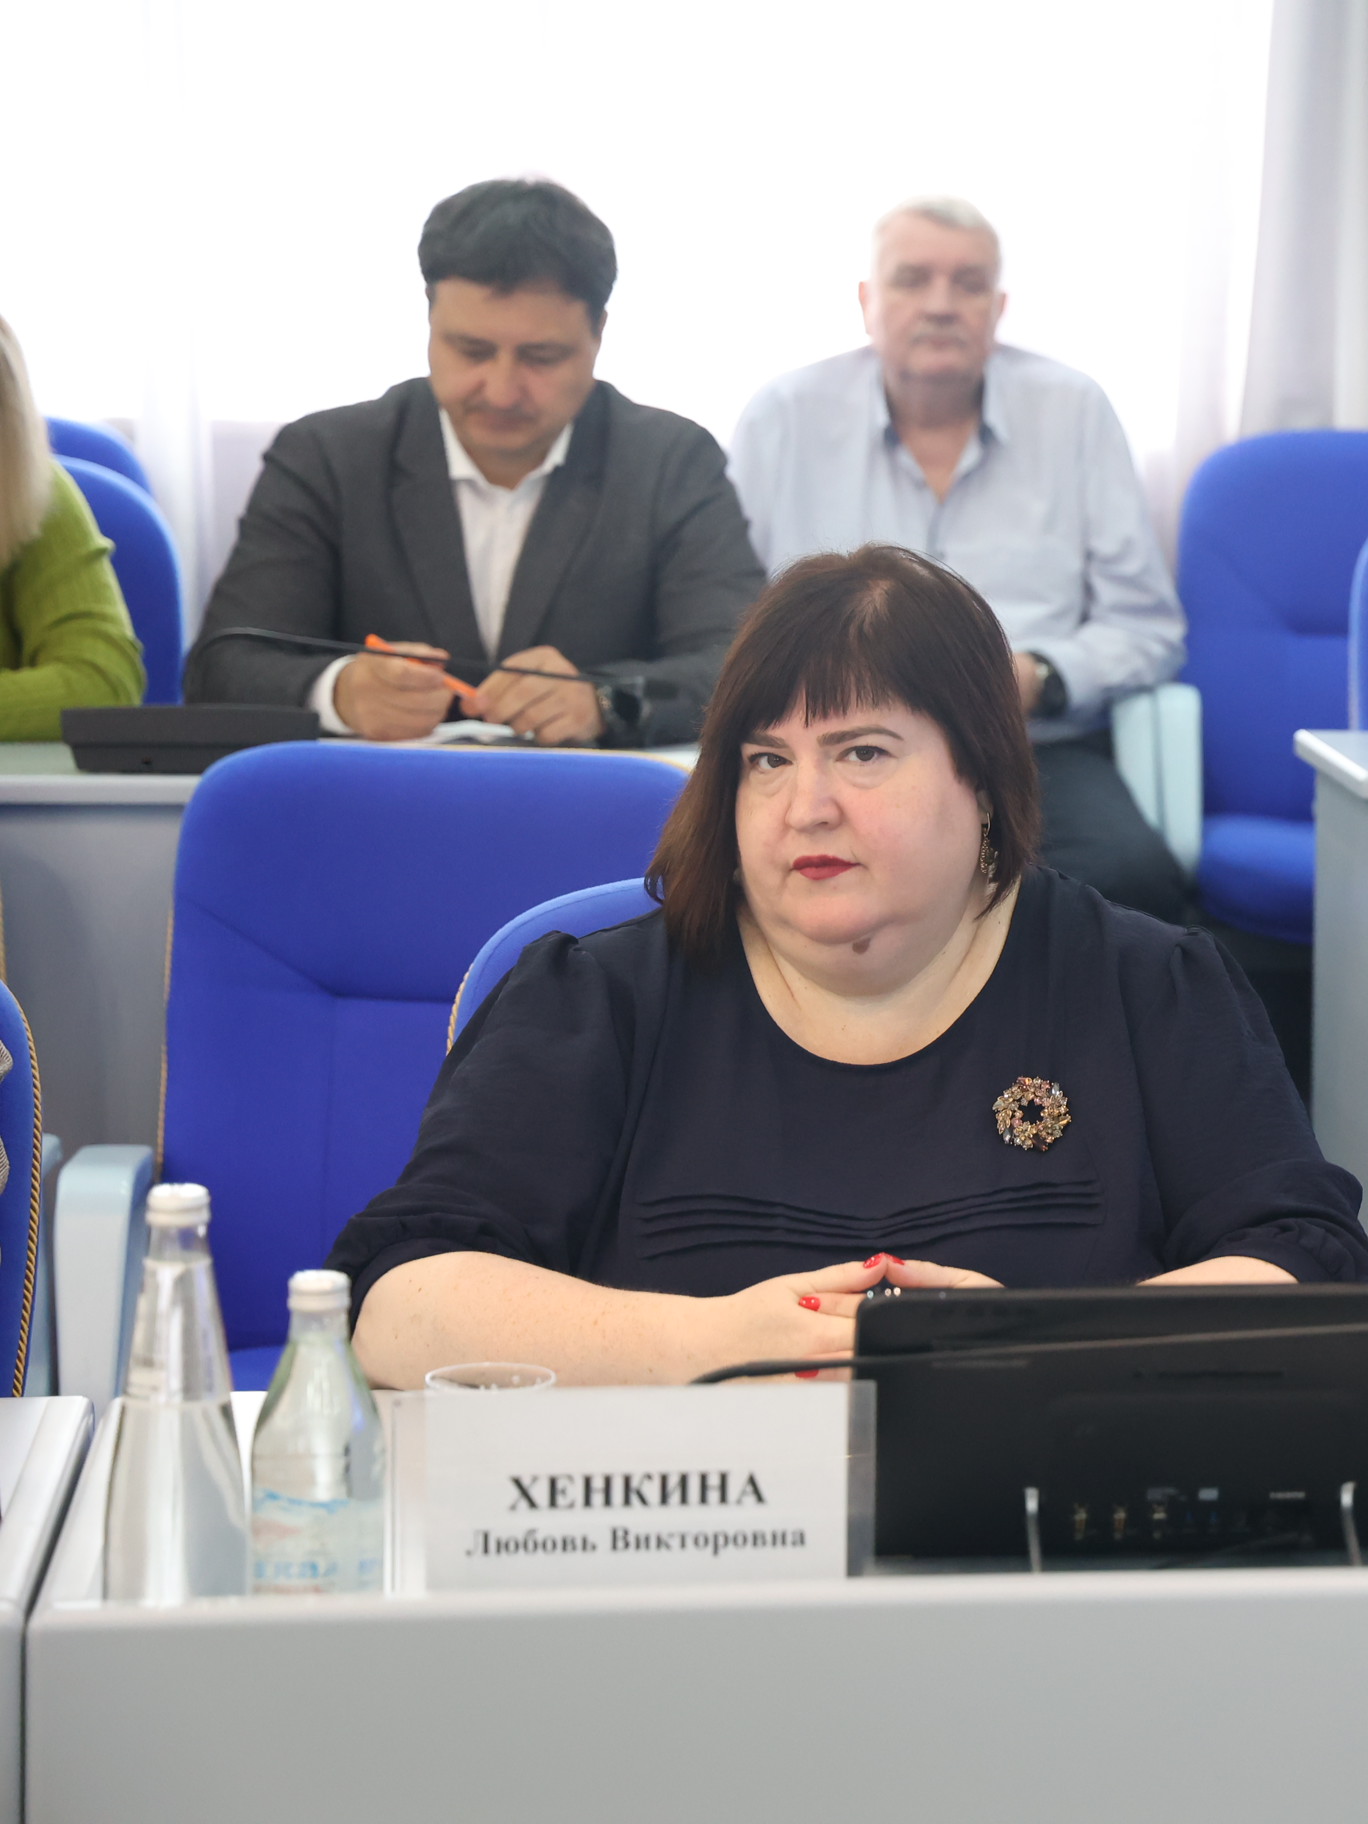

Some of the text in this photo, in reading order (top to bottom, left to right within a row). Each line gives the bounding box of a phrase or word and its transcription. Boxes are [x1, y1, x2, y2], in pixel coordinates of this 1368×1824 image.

[507, 1471, 769, 1511] ХЕНКИНА
[465, 1526, 807, 1558] Любовь Викторовна
